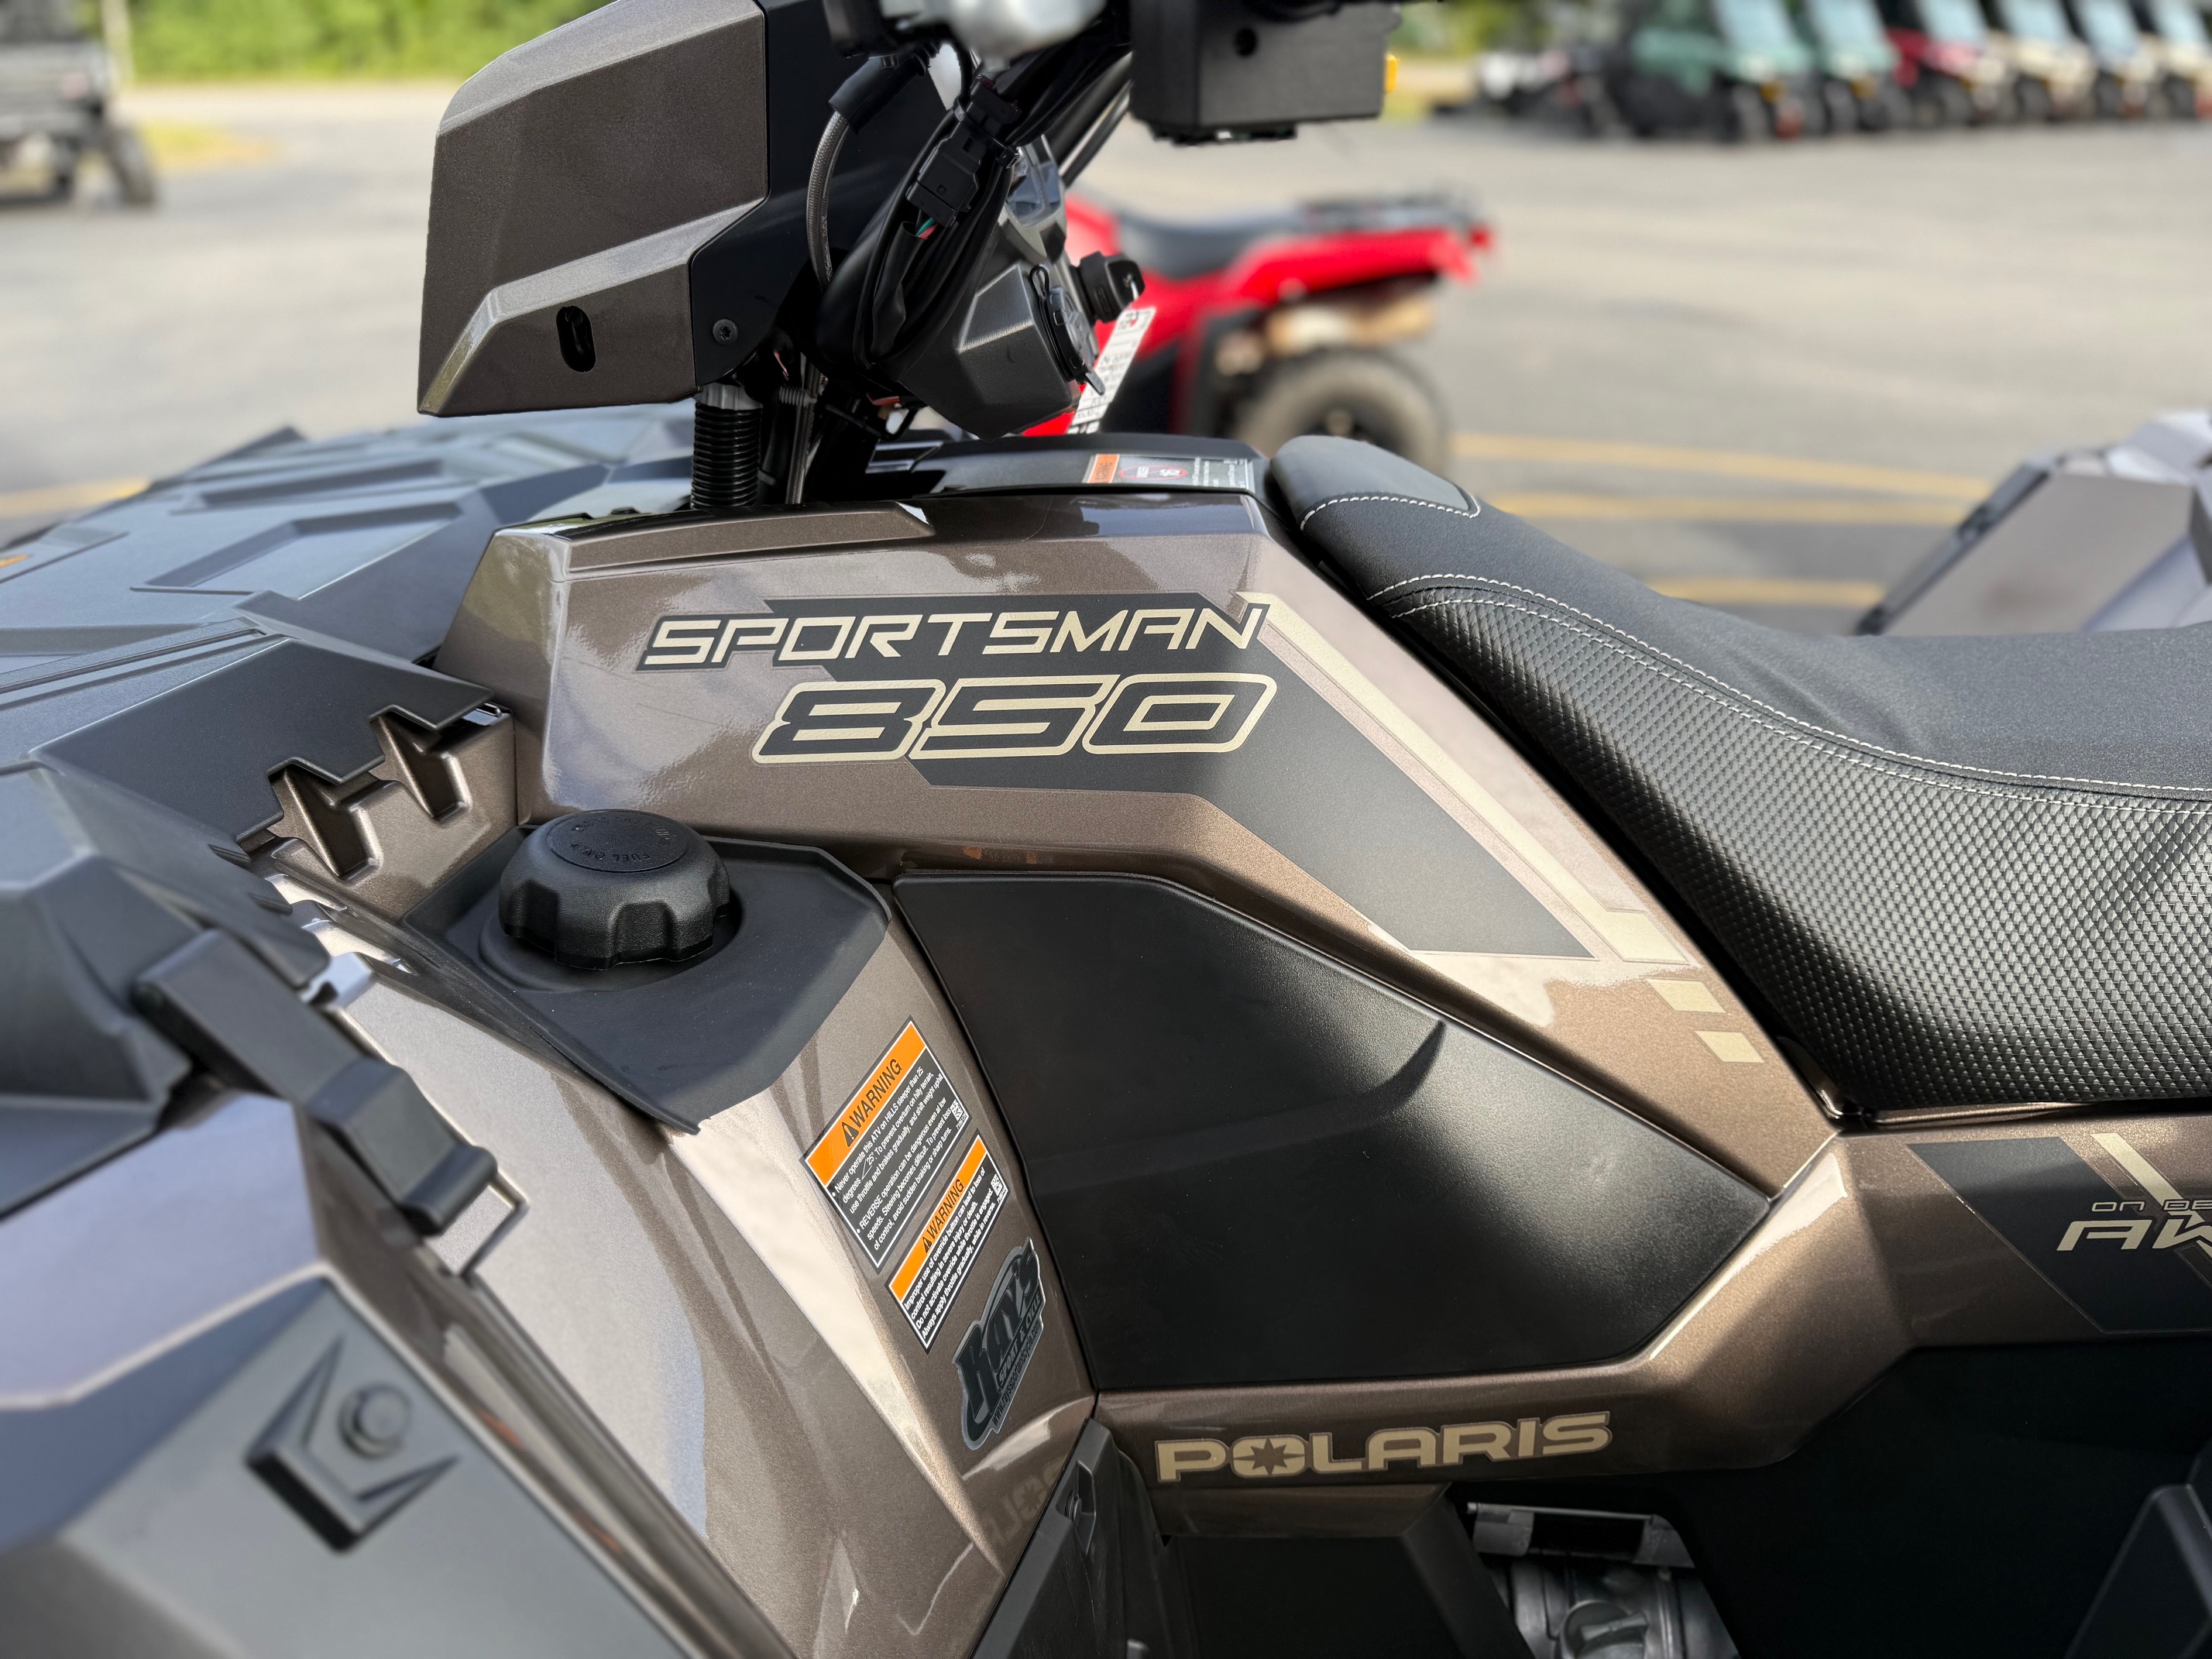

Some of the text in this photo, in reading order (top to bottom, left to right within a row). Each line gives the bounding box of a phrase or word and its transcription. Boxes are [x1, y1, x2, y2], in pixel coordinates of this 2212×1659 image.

[644, 607, 1262, 665] SPORTSMAN
[751, 673, 1278, 763] 850
[834, 1066, 923, 1194] Never operate this ATV on HILLS steeper than 25
[842, 1176, 862, 1205] degrees
[874, 1143, 883, 1156] To
[880, 1124, 897, 1149] prevent
[894, 1103, 911, 1128] overturn
[908, 1096, 915, 1107] on
[912, 1085, 922, 1101] hilly
[919, 1069, 934, 1091] terrain,
[849, 1056, 902, 1131] WARNING
[850, 1200, 860, 1214] use
[857, 1178, 873, 1203] throttle
[870, 1166, 881, 1183] and
[878, 1147, 894, 1170] brakes
[891, 1121, 912, 1153] gradually,
[908, 1111, 917, 1126] and
[915, 1100, 925, 1116] shift
[922, 1085, 936, 1106] weight
[860, 1095, 946, 1231] REVERSE operation can be dangerous even at low
[866, 1106, 951, 1242] speeds. Steering becomes difficult. To prevent loss
[873, 1124, 951, 1252] of control, avoid sudden braking or sharp turns.
[926, 1176, 964, 1242] WARNING
[904, 1276, 924, 1312] Improper
[922, 1266, 930, 1281] use
[927, 1257, 934, 1269] of
[932, 1232, 948, 1262] override
[946, 1214, 959, 1238] button
[963, 1190, 972, 1207] lead
[970, 1184, 975, 1195] to
[973, 1173, 981, 1188] loss
[979, 1166, 985, 1177] of
[910, 1198, 977, 1321] control resulting in severe injury or death.
[916, 1187, 993, 1330] Do not activate override while throttle is engaged.
[921, 1199, 995, 1341] Always apply throttle gradually, while in reverse.
[991, 1317, 1042, 1430] www.rayssportandcycle.com
[998, 1290, 1042, 1386] SPORT & CYCLE
[1156, 1411, 1613, 1482] POLARIS
